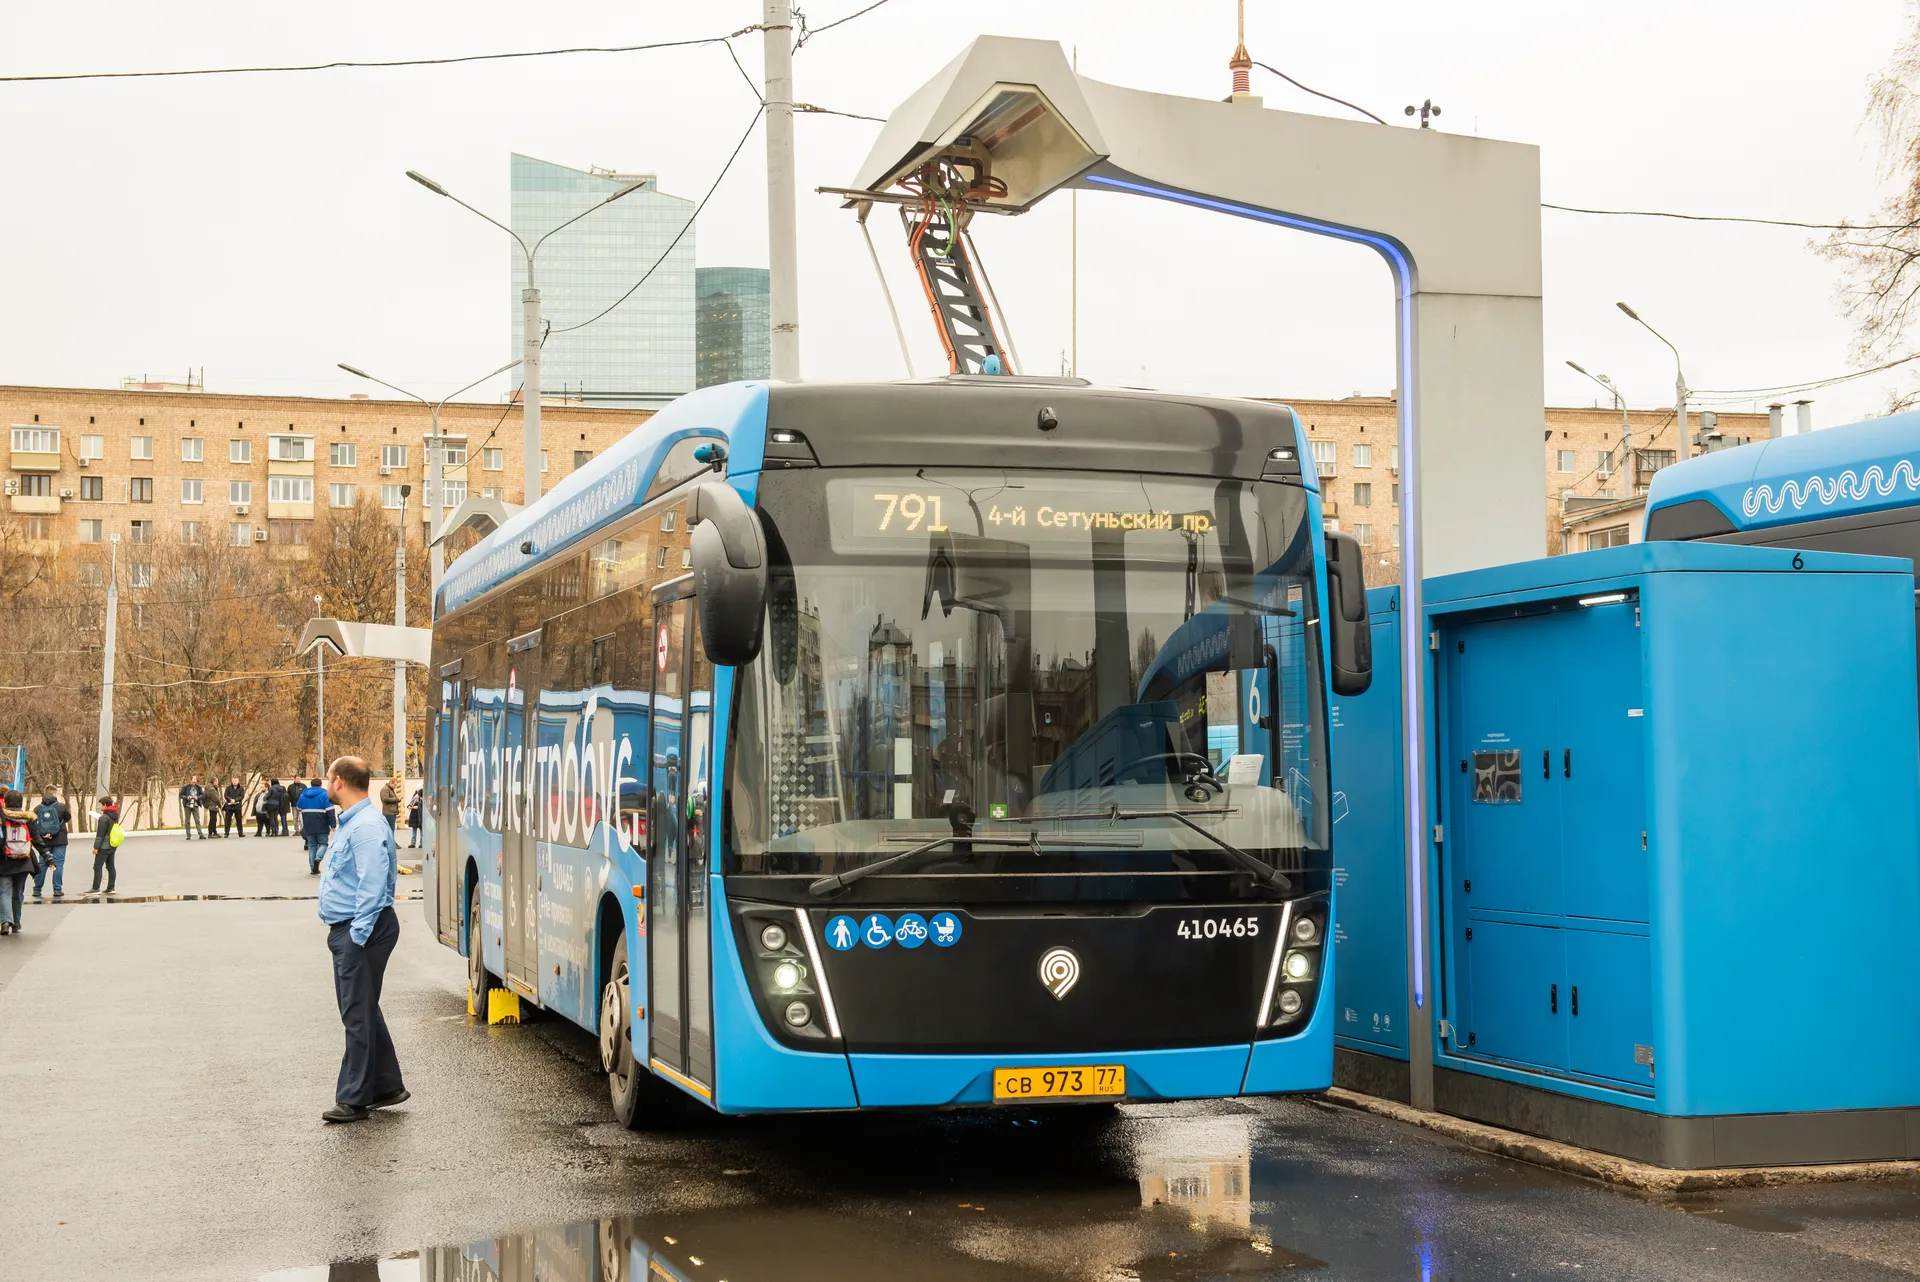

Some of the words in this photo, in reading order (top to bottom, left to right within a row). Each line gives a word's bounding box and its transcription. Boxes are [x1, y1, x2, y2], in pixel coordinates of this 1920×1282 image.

[874, 494, 949, 532] 791
[988, 505, 1026, 526] 4-й
[1037, 506, 1172, 530] Сетуньский
[1791, 552, 1804, 570] 6
[1390, 596, 1396, 611] 6
[1249, 668, 1261, 724] 6
[457, 720, 486, 829] Это
[552, 862, 574, 893] 410465
[1177, 917, 1259, 940] 410465
[1006, 1077, 1032, 1094] СВ
[1042, 1070, 1083, 1093] 973
[1097, 1068, 1117, 1085] 77
